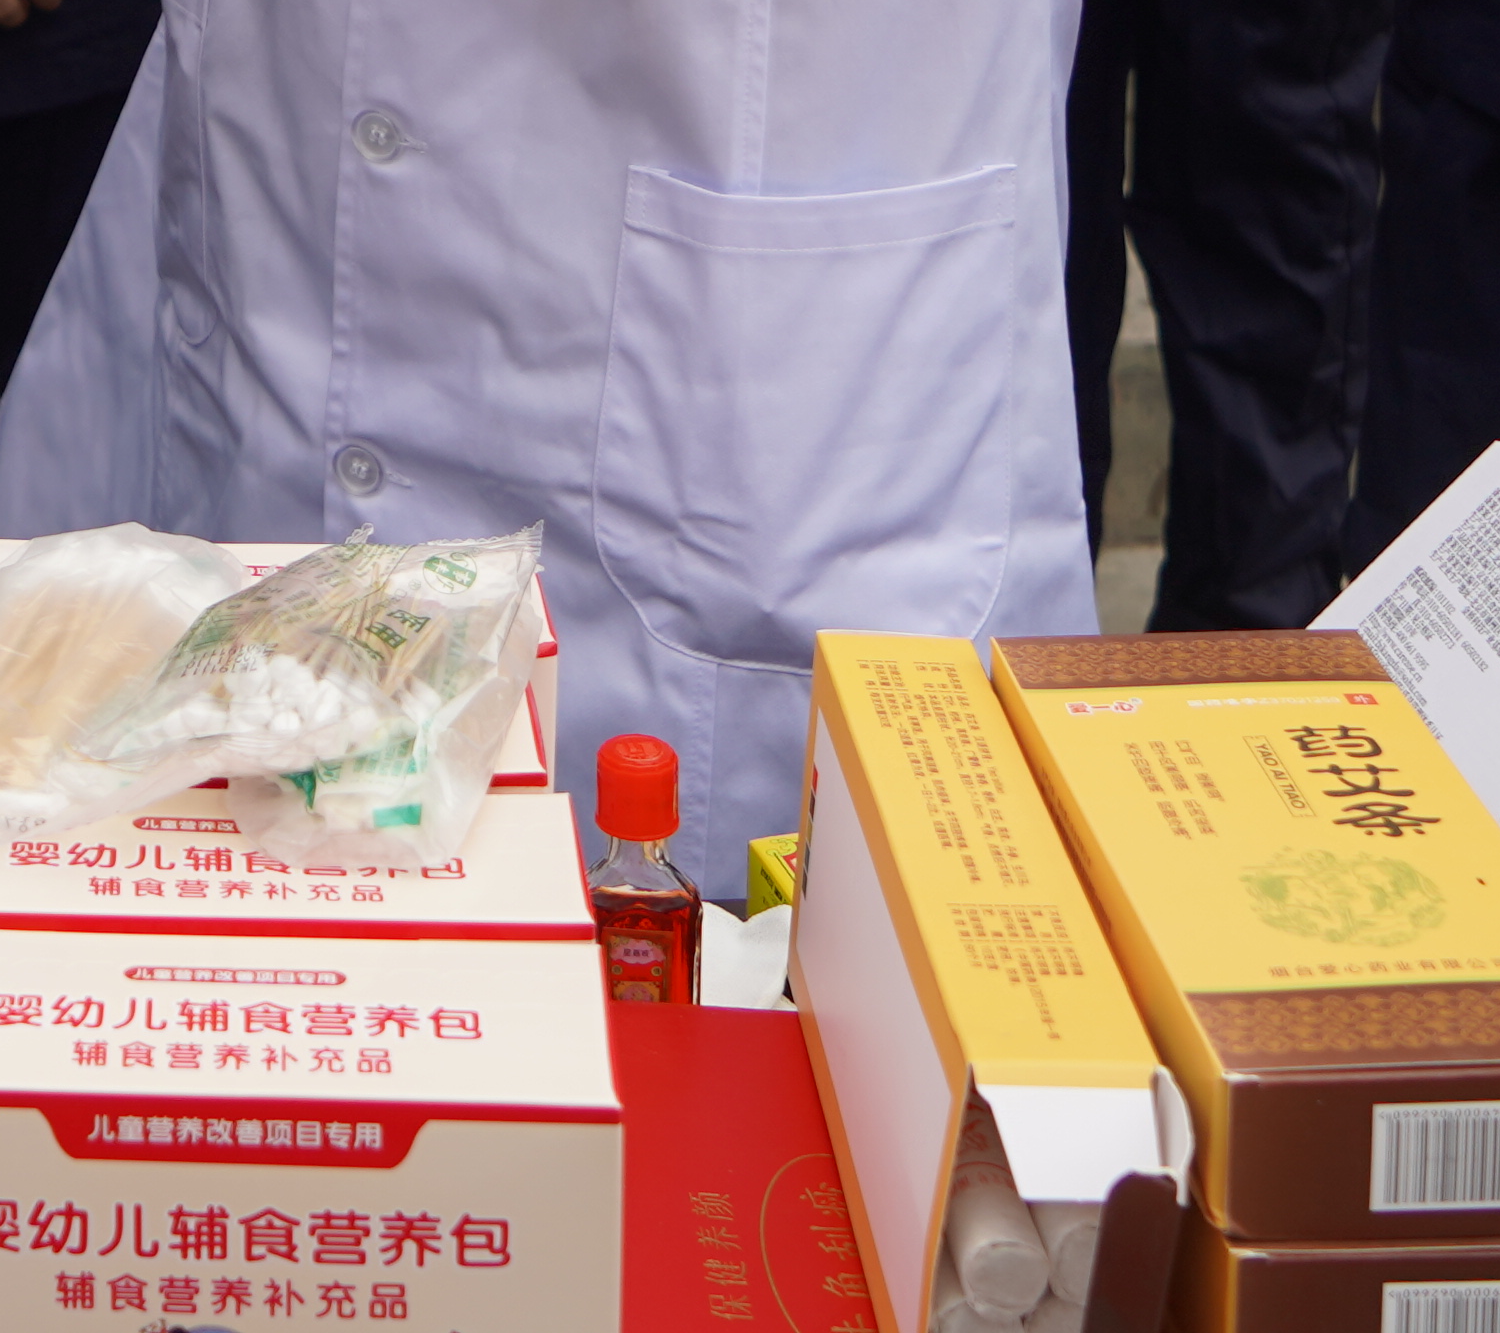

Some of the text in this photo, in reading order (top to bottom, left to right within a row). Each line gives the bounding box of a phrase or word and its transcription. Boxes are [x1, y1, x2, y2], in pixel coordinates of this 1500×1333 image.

[1256, 738, 1279, 768] YAO
[1279, 779, 1306, 813] TIAO
[88, 875, 385, 903] 辅食营养补充品
[132, 967, 337, 985] 儿童营养改善项目专用
[71, 1039, 393, 1074] 辅食营养补充品
[87, 1113, 384, 1149] 儿童营养改善项目专用
[688, 1191, 754, 1320] 保健养颜
[56, 1270, 410, 1321] 辅食营养补充品
